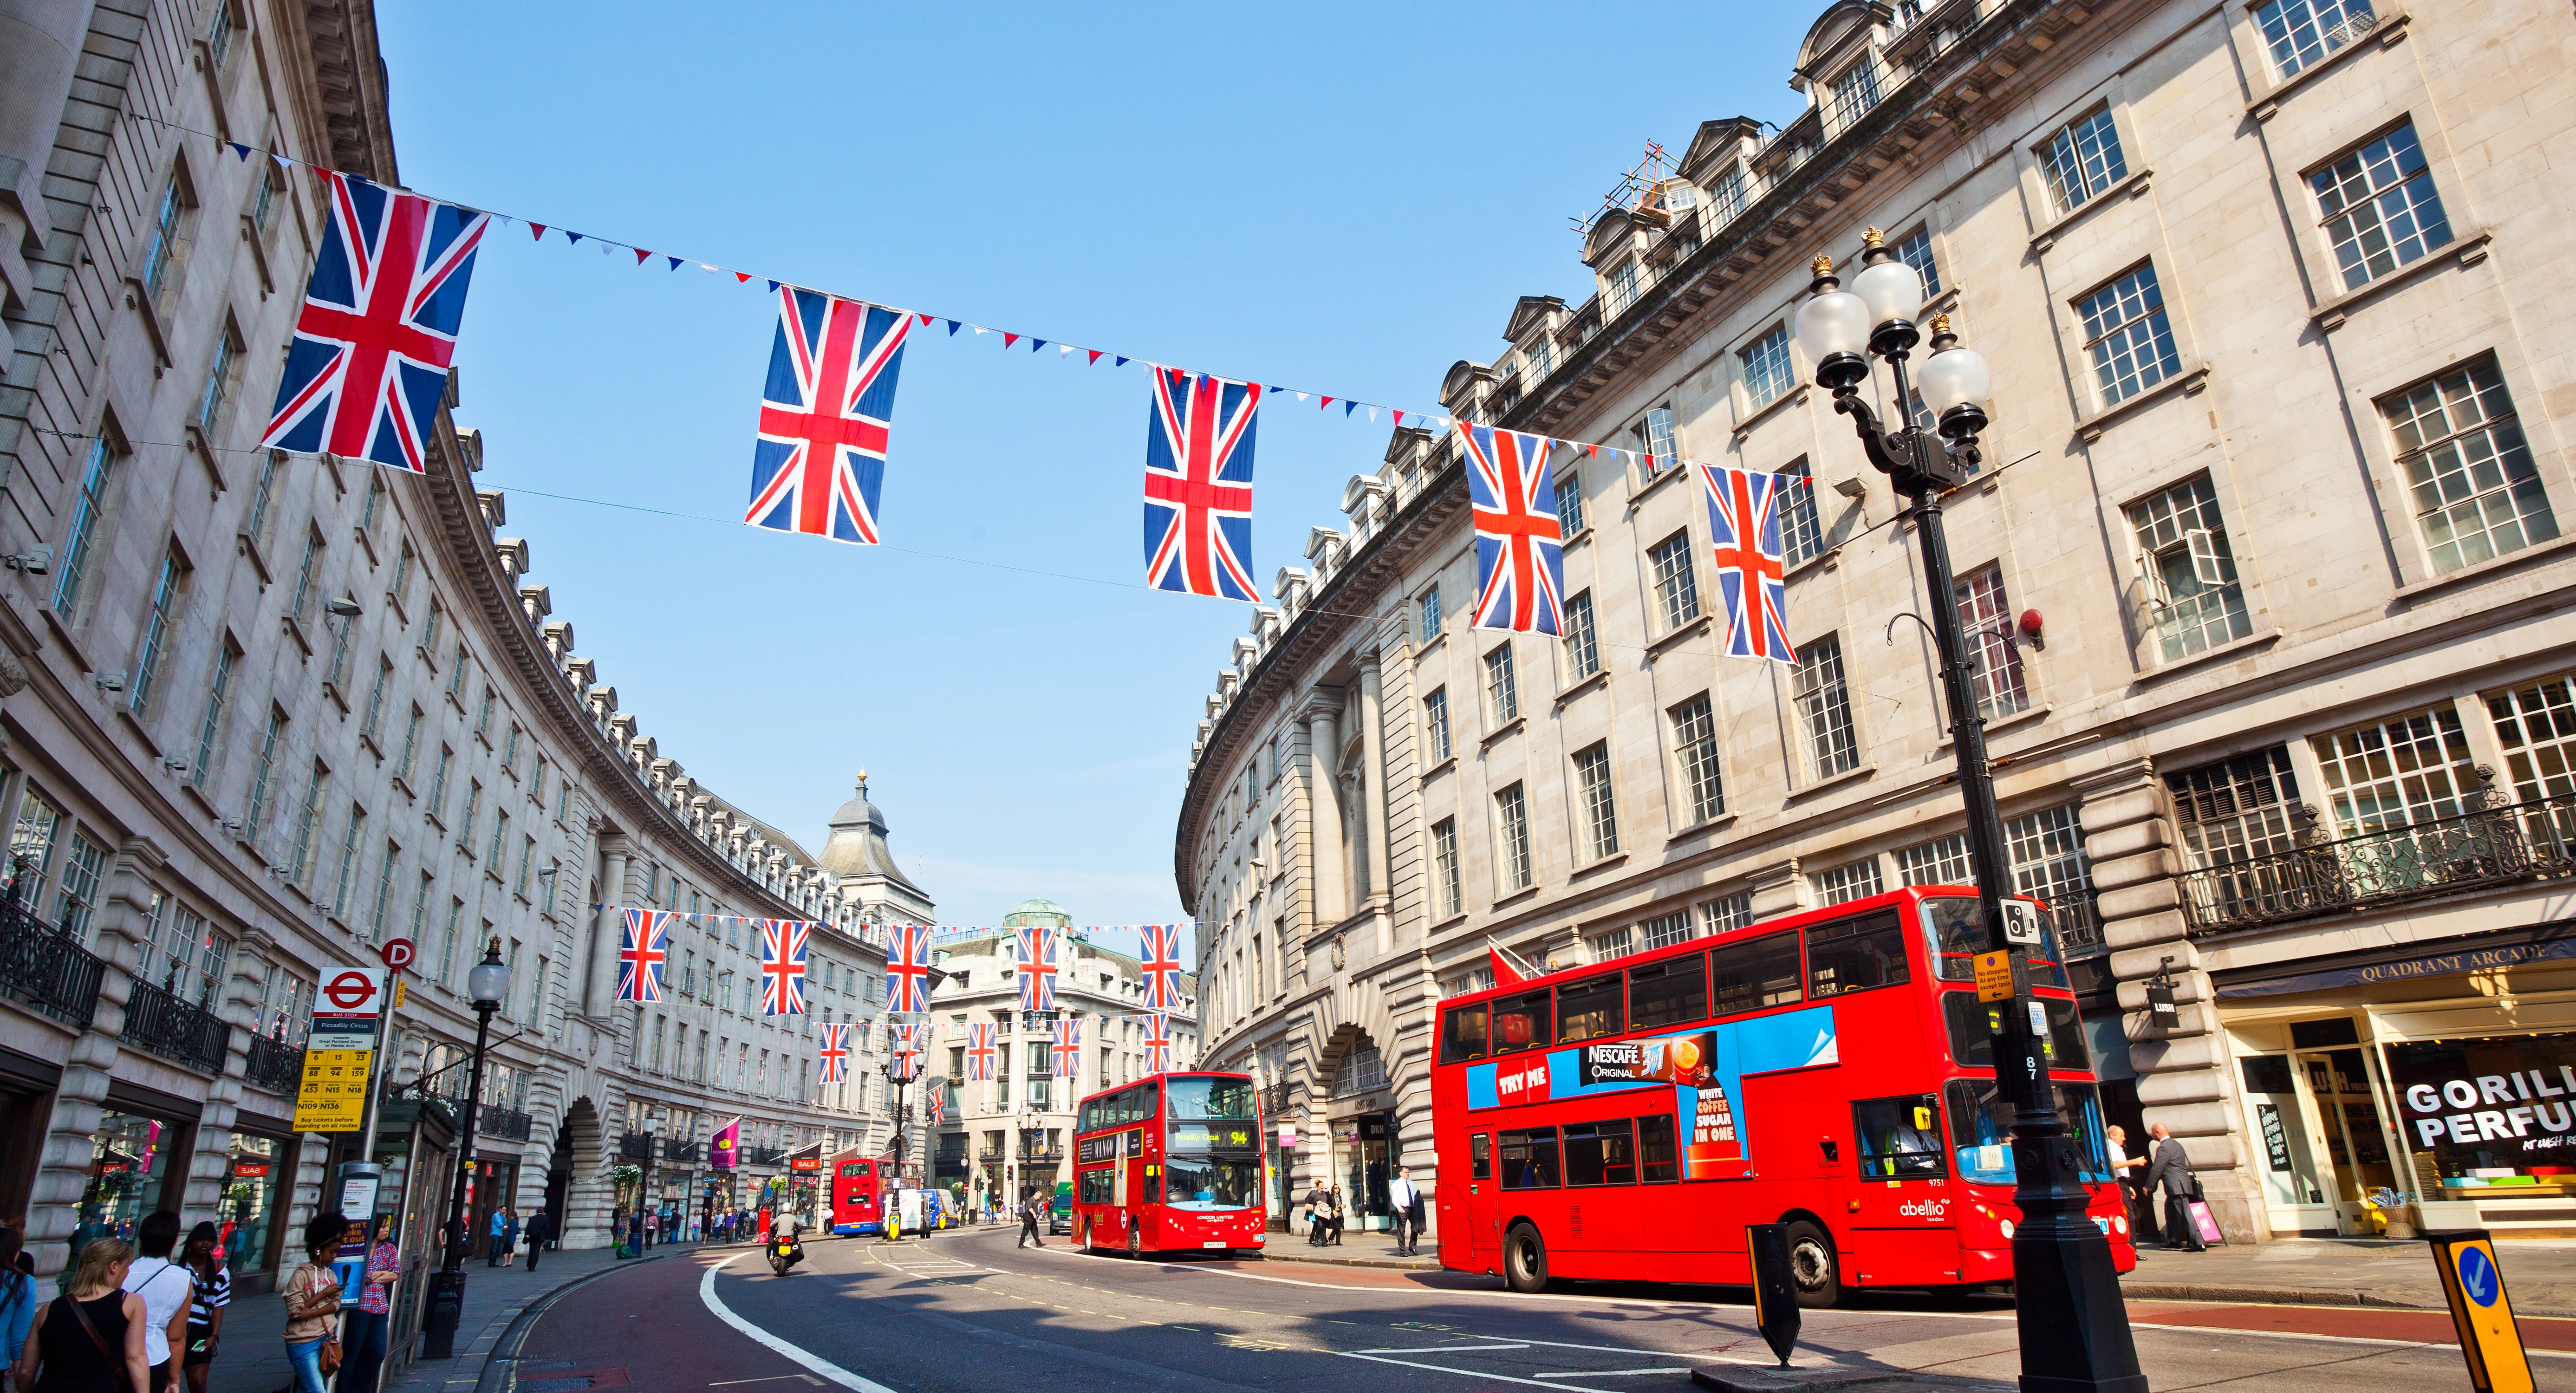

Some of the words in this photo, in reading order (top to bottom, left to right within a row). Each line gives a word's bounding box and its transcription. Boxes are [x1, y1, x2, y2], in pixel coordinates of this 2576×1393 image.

[390, 944, 411, 964] D
[2361, 956, 2462, 981] QUADRANT
[2470, 944, 2549, 967] ARCADE
[2154, 1003, 2175, 1012] LUSH
[1589, 1045, 1638, 1064] NESCAFÉ
[1591, 1065, 1635, 1078] ORIGINAL
[1499, 1072, 1524, 1095] TRY
[1527, 1066, 1547, 1088] ME
[1698, 1087, 1723, 1100] WHITE
[1697, 1099, 1728, 1114] COFFEE
[1696, 1113, 1732, 1127] SUGAR
[1176, 1133, 1200, 1142] Piccadilly
[1231, 1132, 1247, 1144] 94
[1695, 1128, 1708, 1143] IN
[1711, 1126, 1735, 1142] ONE
[1095, 1139, 1113, 1159] MANGO
[2523, 1139, 2538, 1151] AT
[2538, 1135, 2564, 1148] LUSH
[1988, 1151, 1997, 1162] 10
[1900, 1200, 1944, 1216] abellio
